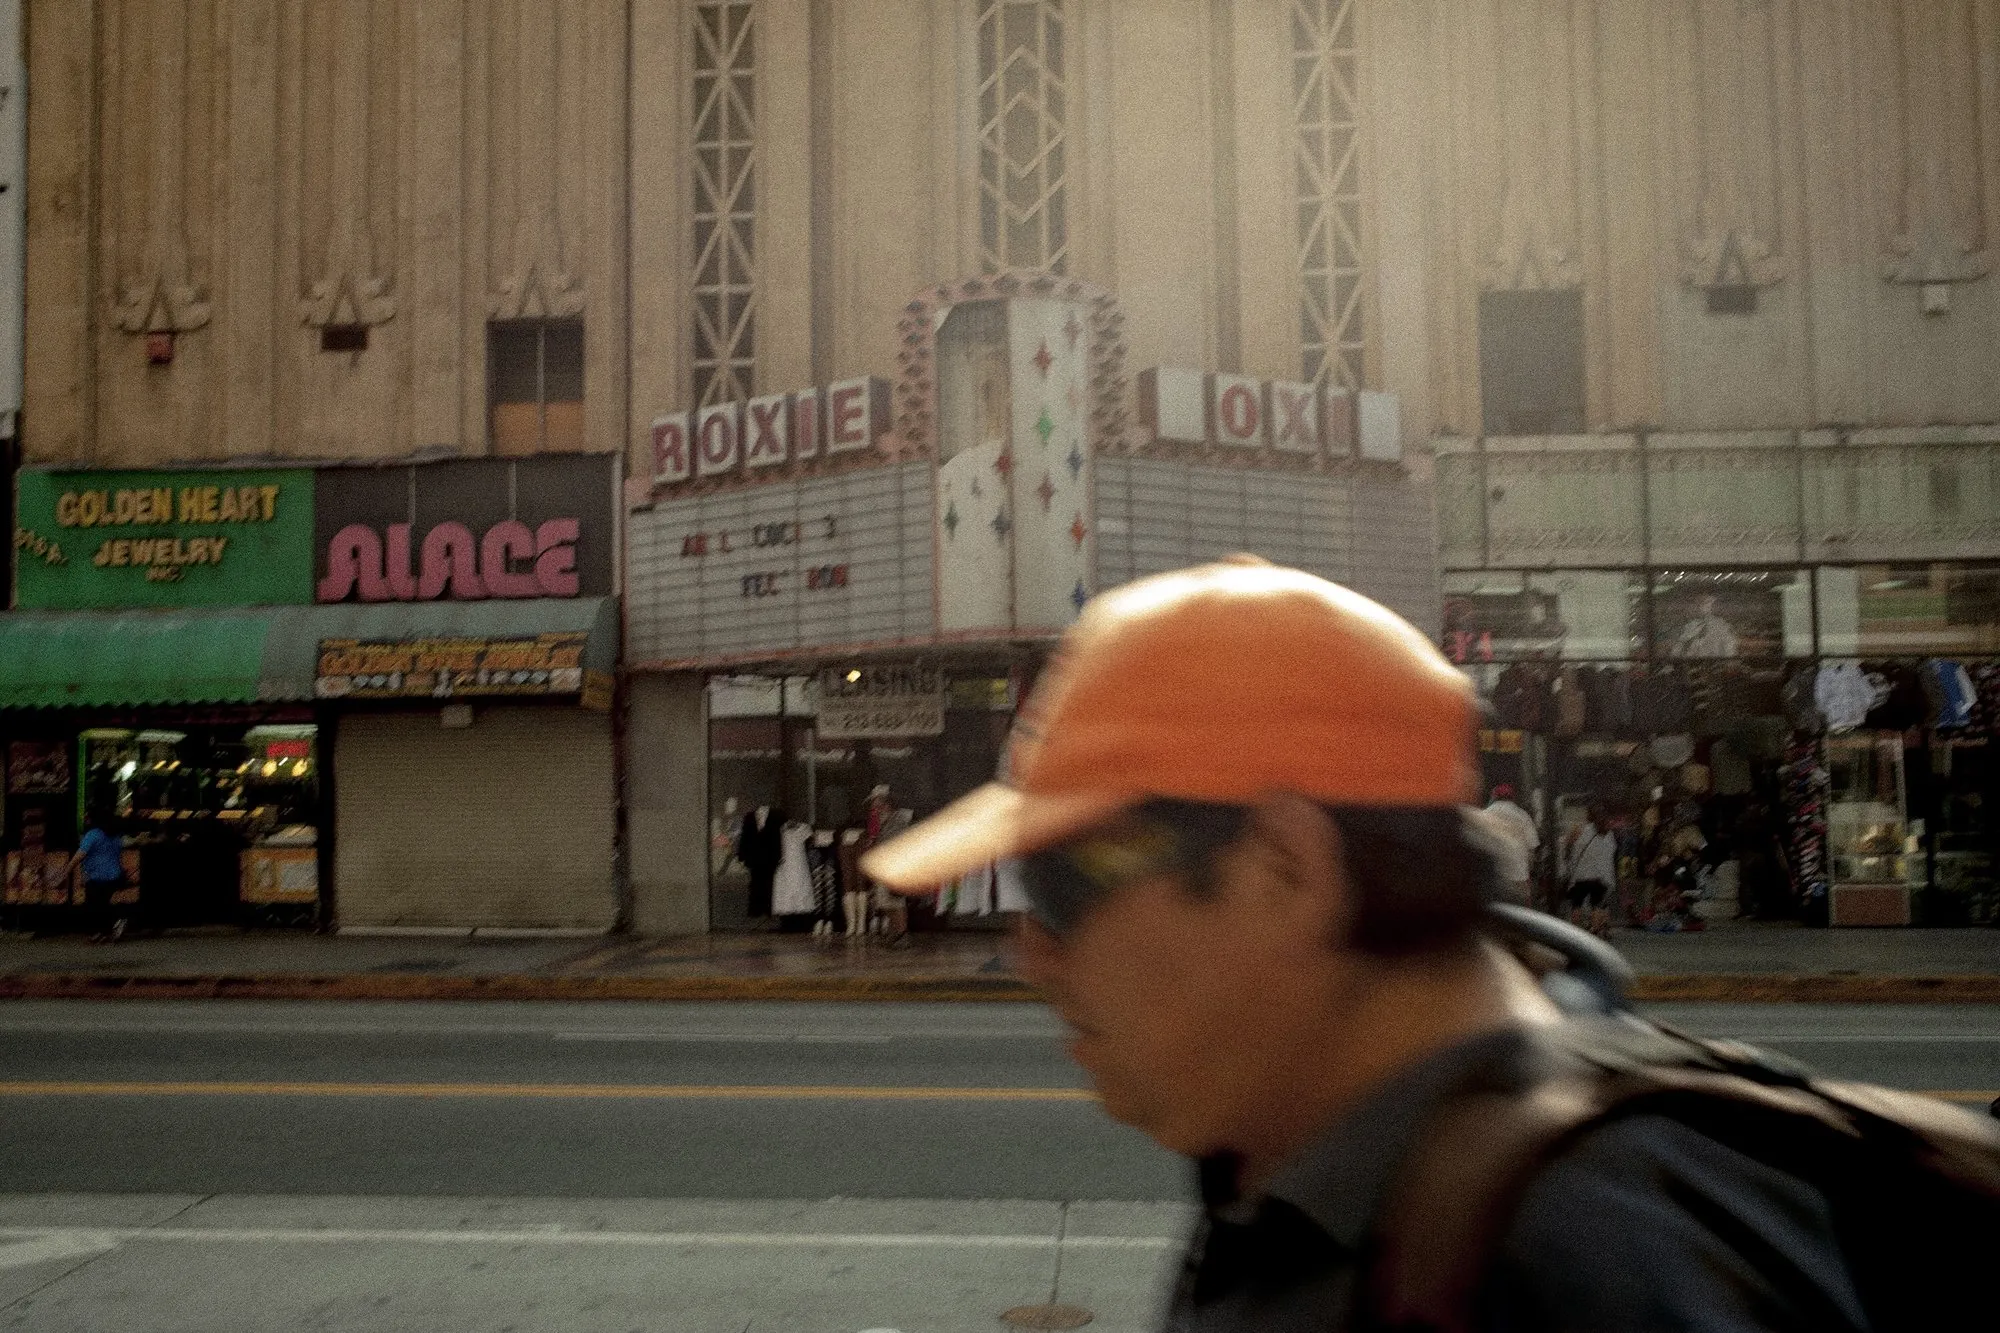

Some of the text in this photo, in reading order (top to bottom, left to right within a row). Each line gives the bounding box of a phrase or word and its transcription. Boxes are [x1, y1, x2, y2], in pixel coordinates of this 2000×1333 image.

[652, 386, 863, 474] ROXIE
[56, 485, 279, 527] GOLDEN HEART
[93, 537, 228, 567] JEWELRY
